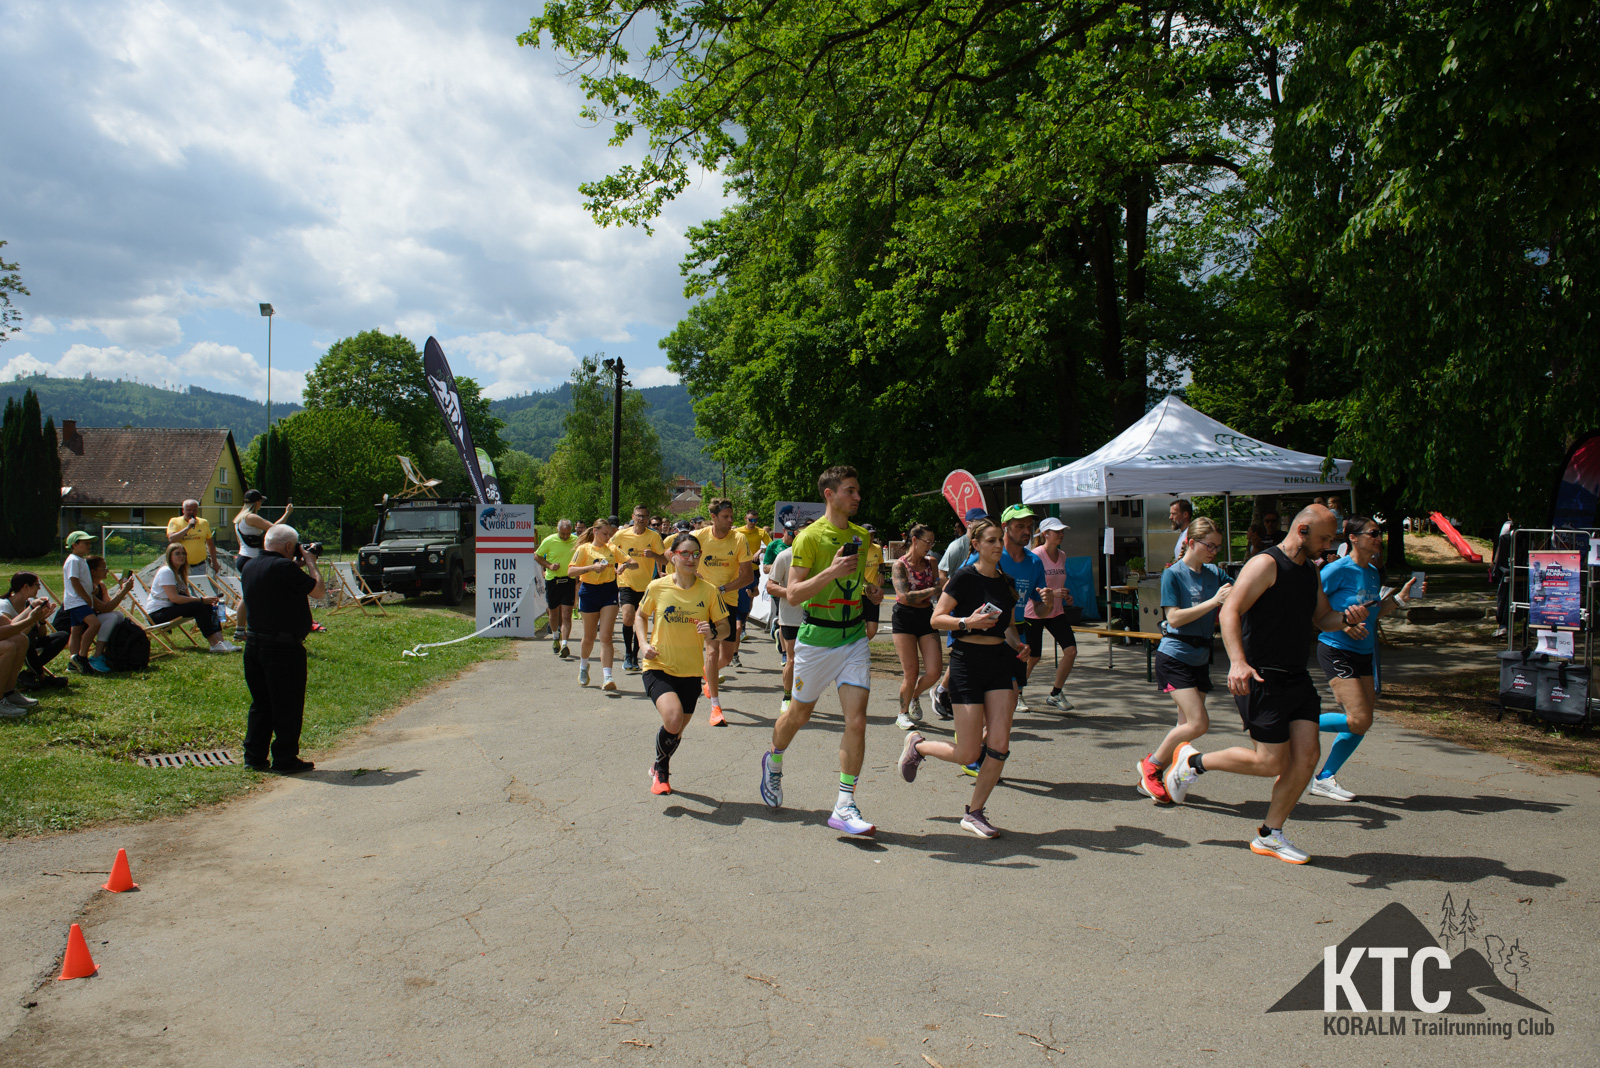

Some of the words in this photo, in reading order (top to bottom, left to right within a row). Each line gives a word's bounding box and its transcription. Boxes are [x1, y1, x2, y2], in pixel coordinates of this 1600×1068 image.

[1145, 448, 1284, 462] KIRSCHALLEE
[1284, 475, 1345, 484] KIRSCHLLEE
[493, 558, 517, 570] RUN
[494, 572, 516, 585] FOR
[487, 587, 523, 599] THOSE
[492, 601, 519, 614] WHO
